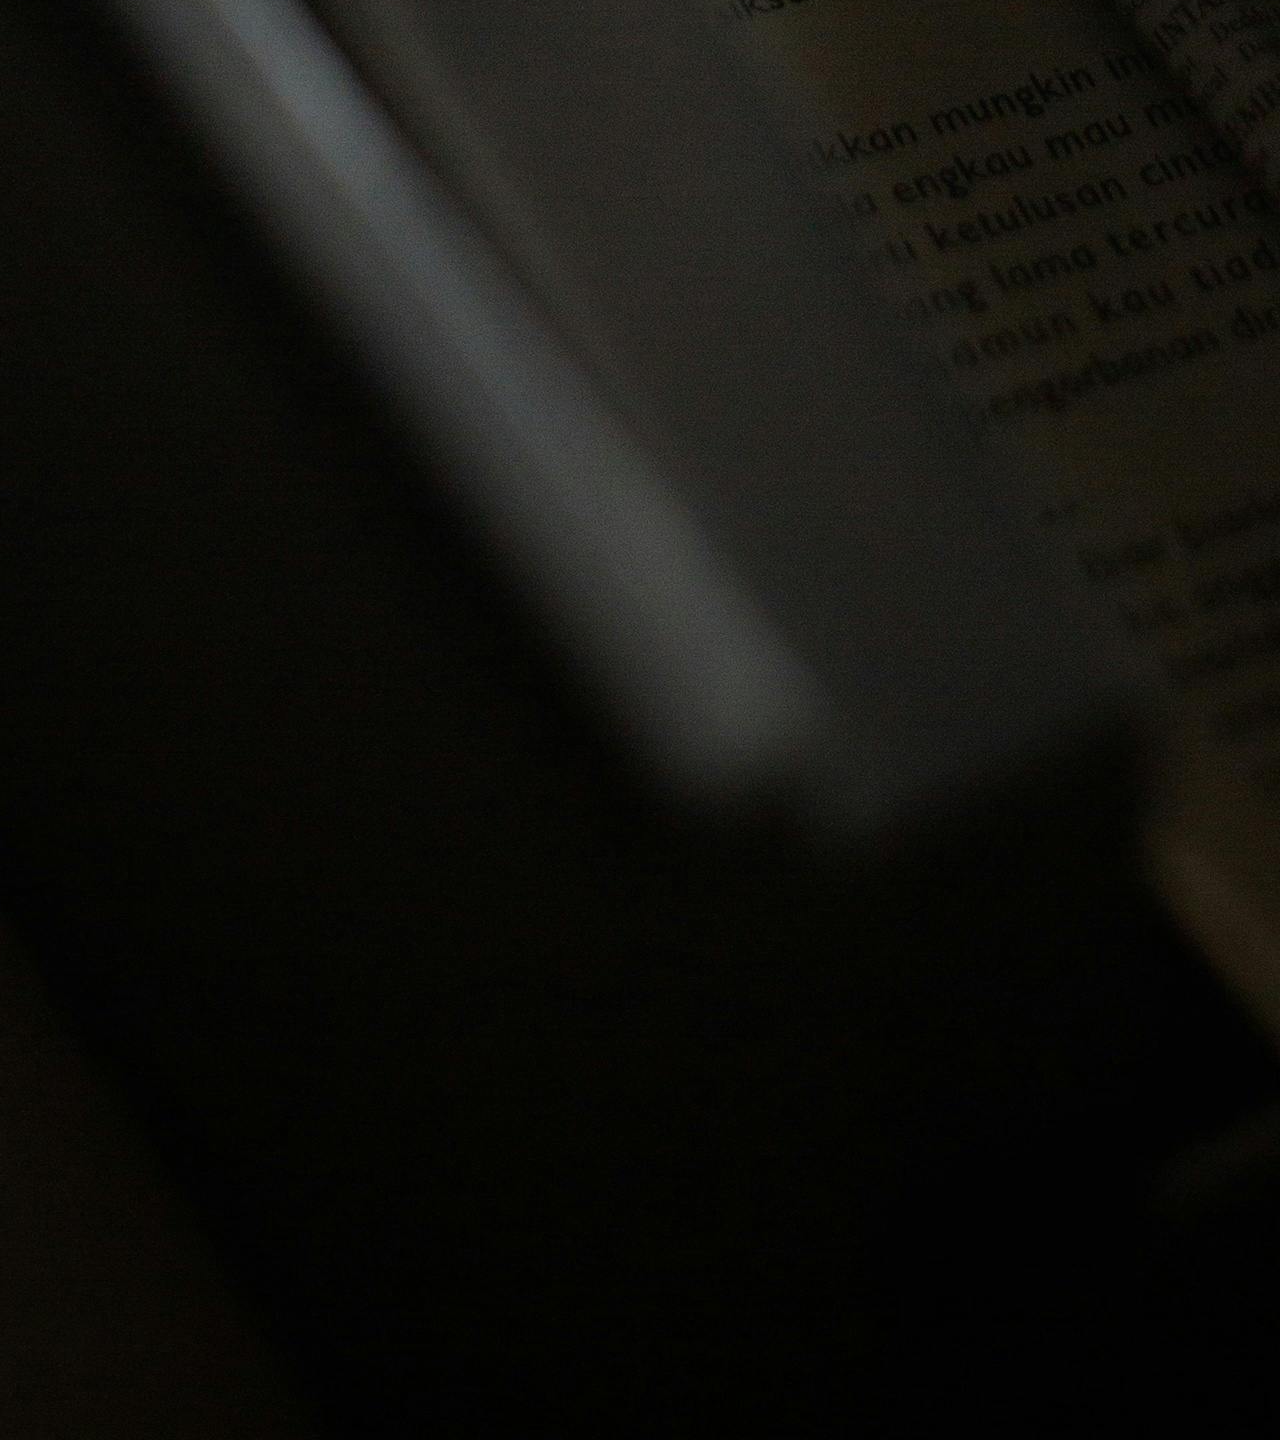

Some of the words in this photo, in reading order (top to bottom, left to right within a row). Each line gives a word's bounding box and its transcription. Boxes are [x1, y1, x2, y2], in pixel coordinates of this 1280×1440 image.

[809, 118, 919, 171] kkan
[928, 65, 1096, 136] mungkin
[891, 143, 1034, 204] engkau
[1044, 111, 1134, 163] mau
[906, 278, 989, 326] ang
[988, 241, 1099, 294] lama
[1106, 185, 1270, 258] tercura
[924, 176, 1128, 254] ketulusan
[950, 310, 1080, 369] amun
[1086, 279, 1176, 324] kau
[978, 324, 1220, 418] engorbanan
